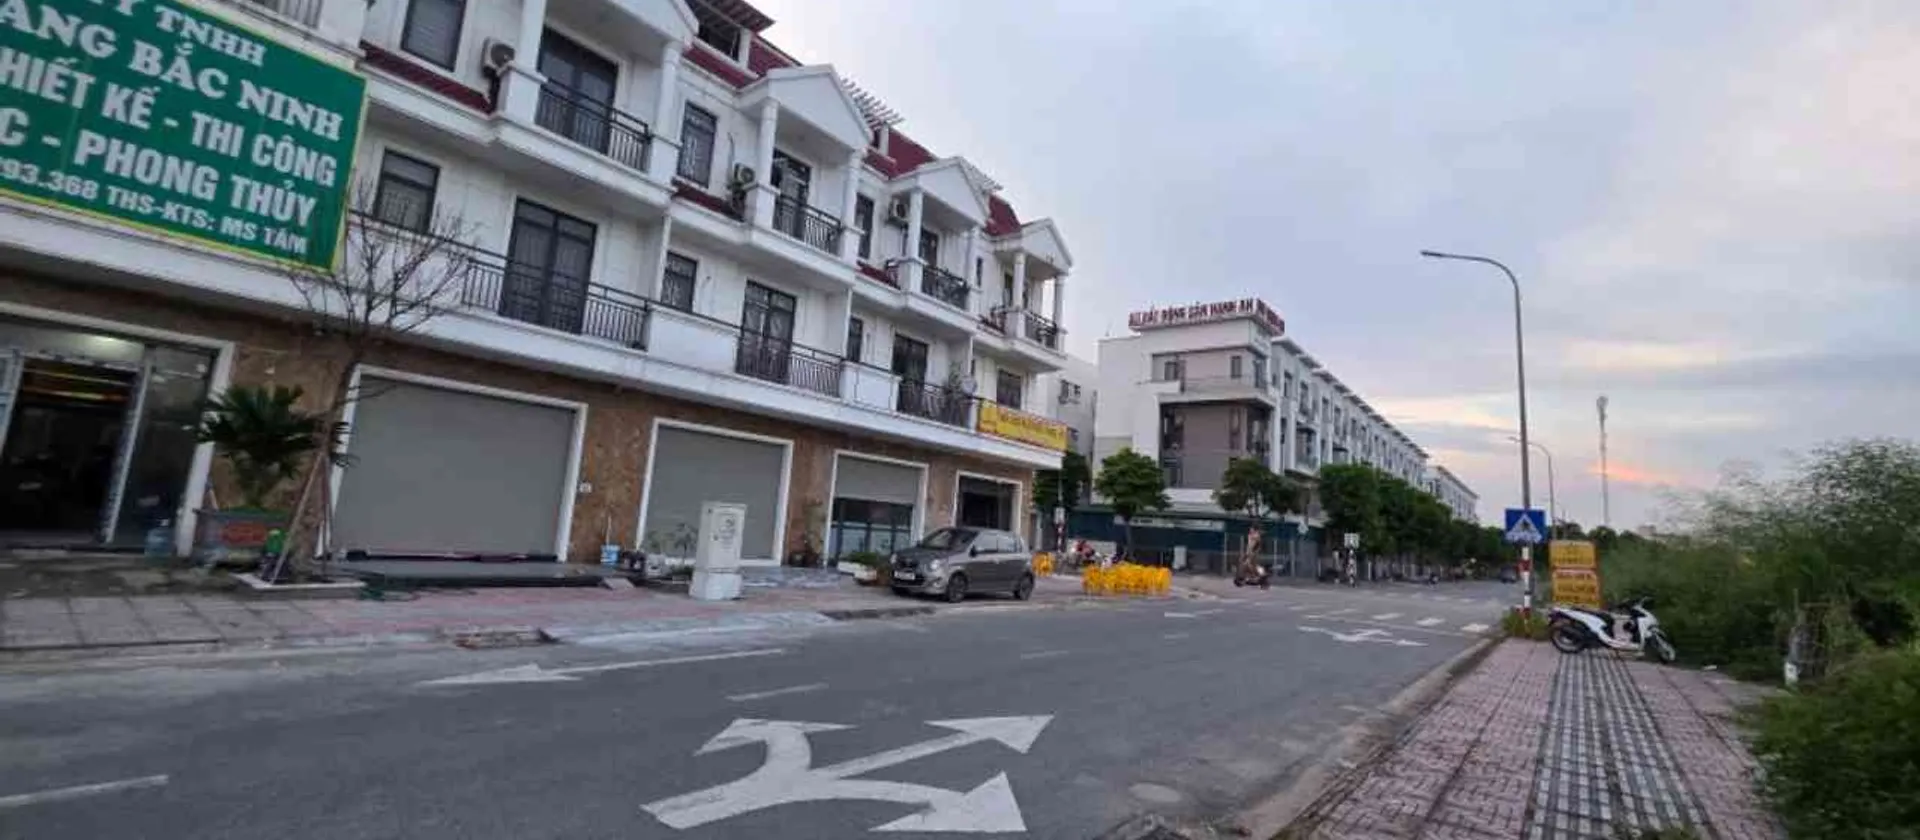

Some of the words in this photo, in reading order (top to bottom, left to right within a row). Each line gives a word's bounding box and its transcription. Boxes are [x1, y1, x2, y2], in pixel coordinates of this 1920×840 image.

[155, 5, 268, 67] TNHH
[101, 81, 161, 129] KẾ
[191, 110, 245, 158] THI
[251, 134, 337, 187] CÔNG
[127, 38, 229, 99] BẮC
[237, 79, 344, 142] NINH
[73, 129, 219, 201] PHONG
[230, 174, 317, 227] THỦY
[220, 215, 258, 241] MS
